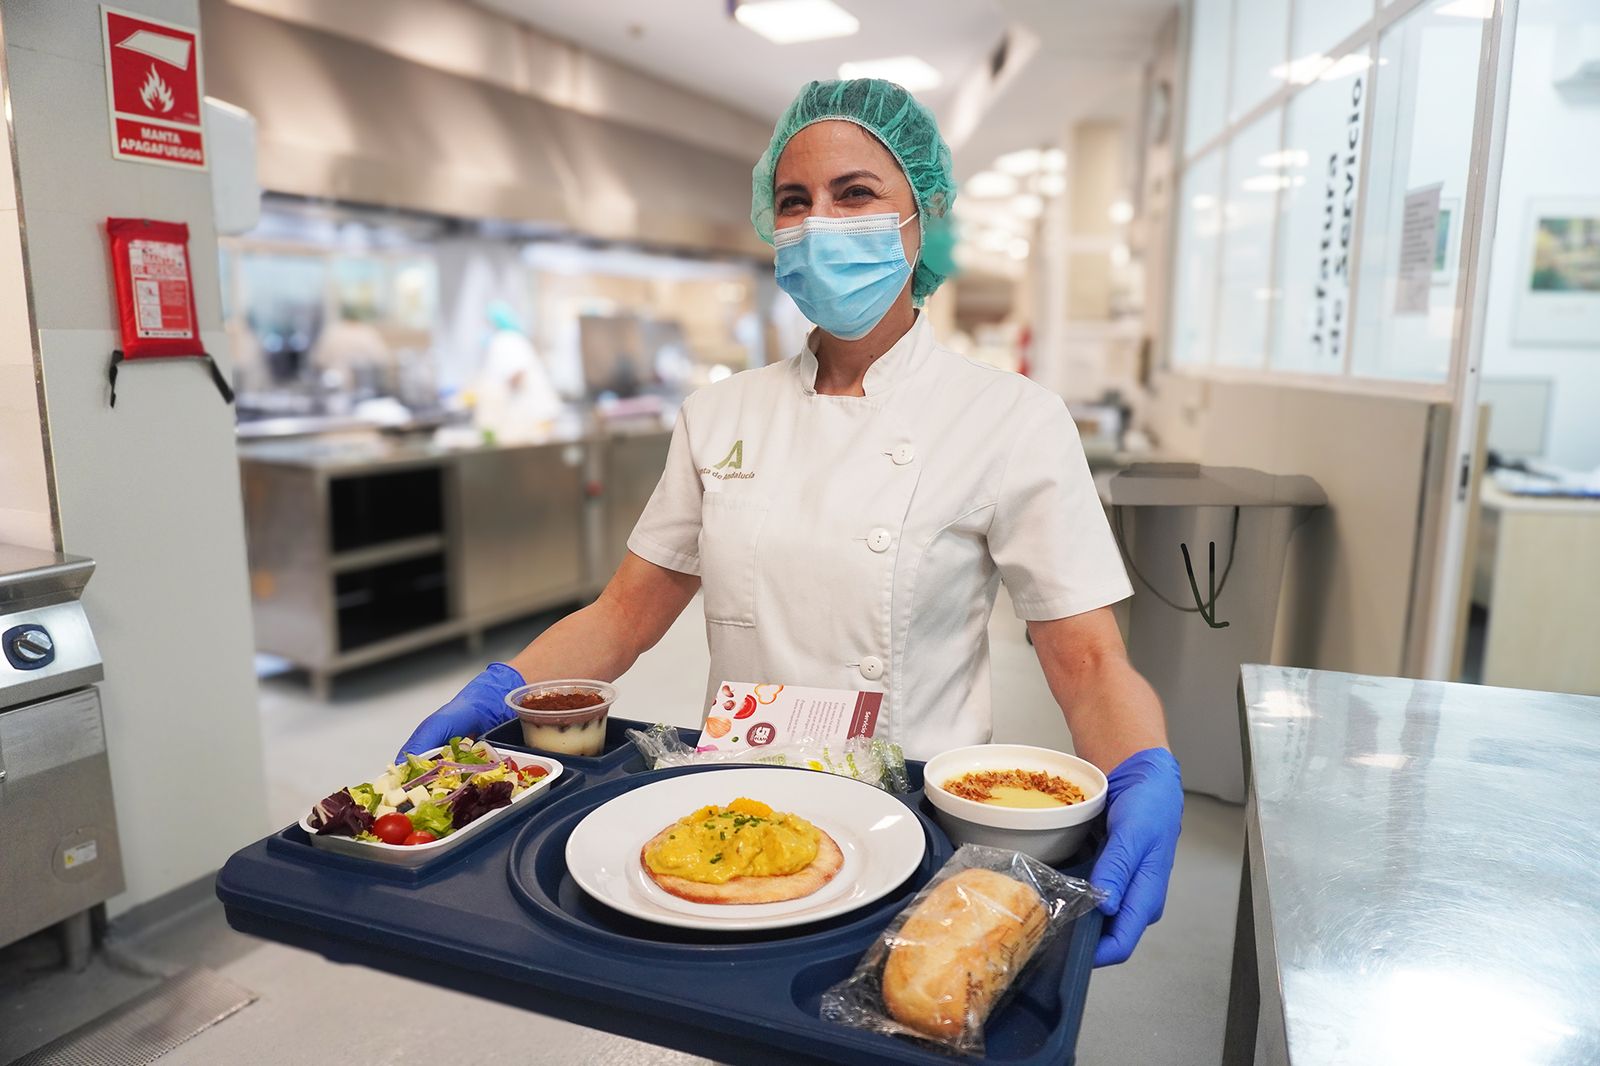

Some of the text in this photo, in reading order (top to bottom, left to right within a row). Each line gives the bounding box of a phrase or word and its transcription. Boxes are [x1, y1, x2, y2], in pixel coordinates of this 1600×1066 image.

[141, 127, 181, 145] MANTA
[120, 137, 203, 160] APAGAFUEGOS
[1329, 76, 1362, 357] de Servicio
[1311, 152, 1338, 356] Jefatura
[860, 711, 871, 734] Servicio
